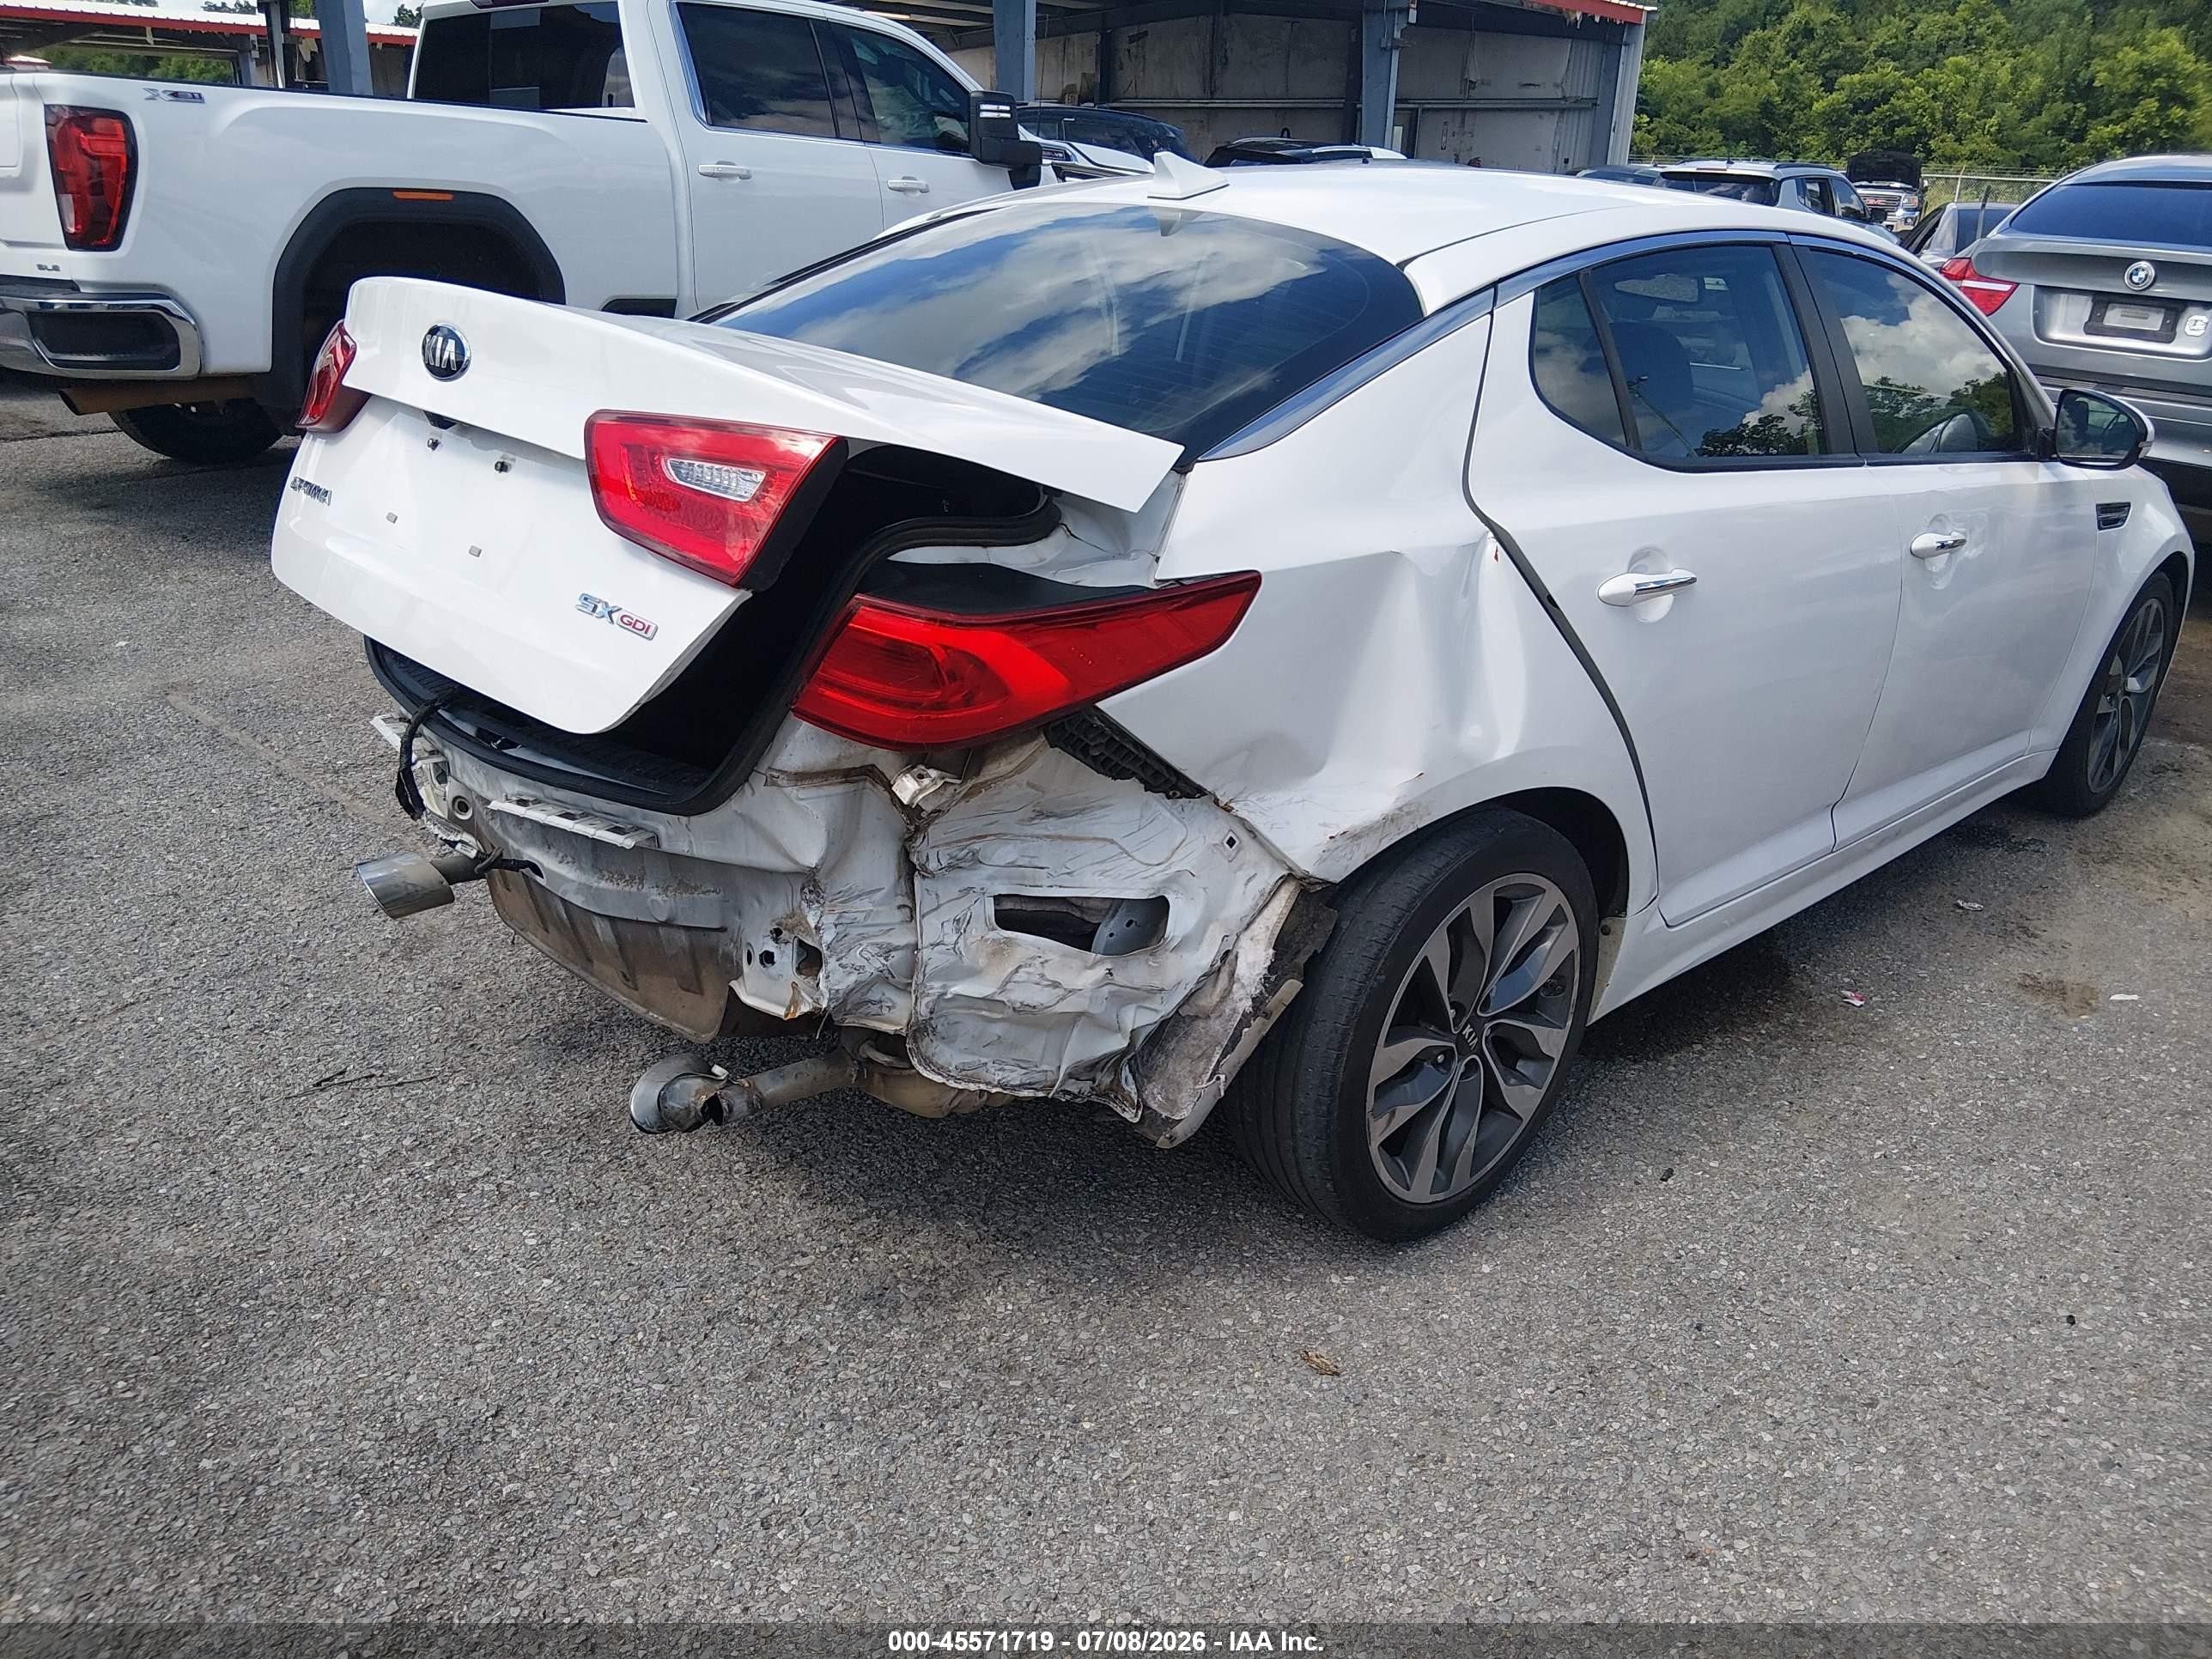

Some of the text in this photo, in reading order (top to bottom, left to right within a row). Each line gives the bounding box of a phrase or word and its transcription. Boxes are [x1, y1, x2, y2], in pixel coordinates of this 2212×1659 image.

[425, 334, 457, 370] KIA
[576, 592, 652, 635] SX GDI
[1462, 1023, 1479, 1050] KIA
